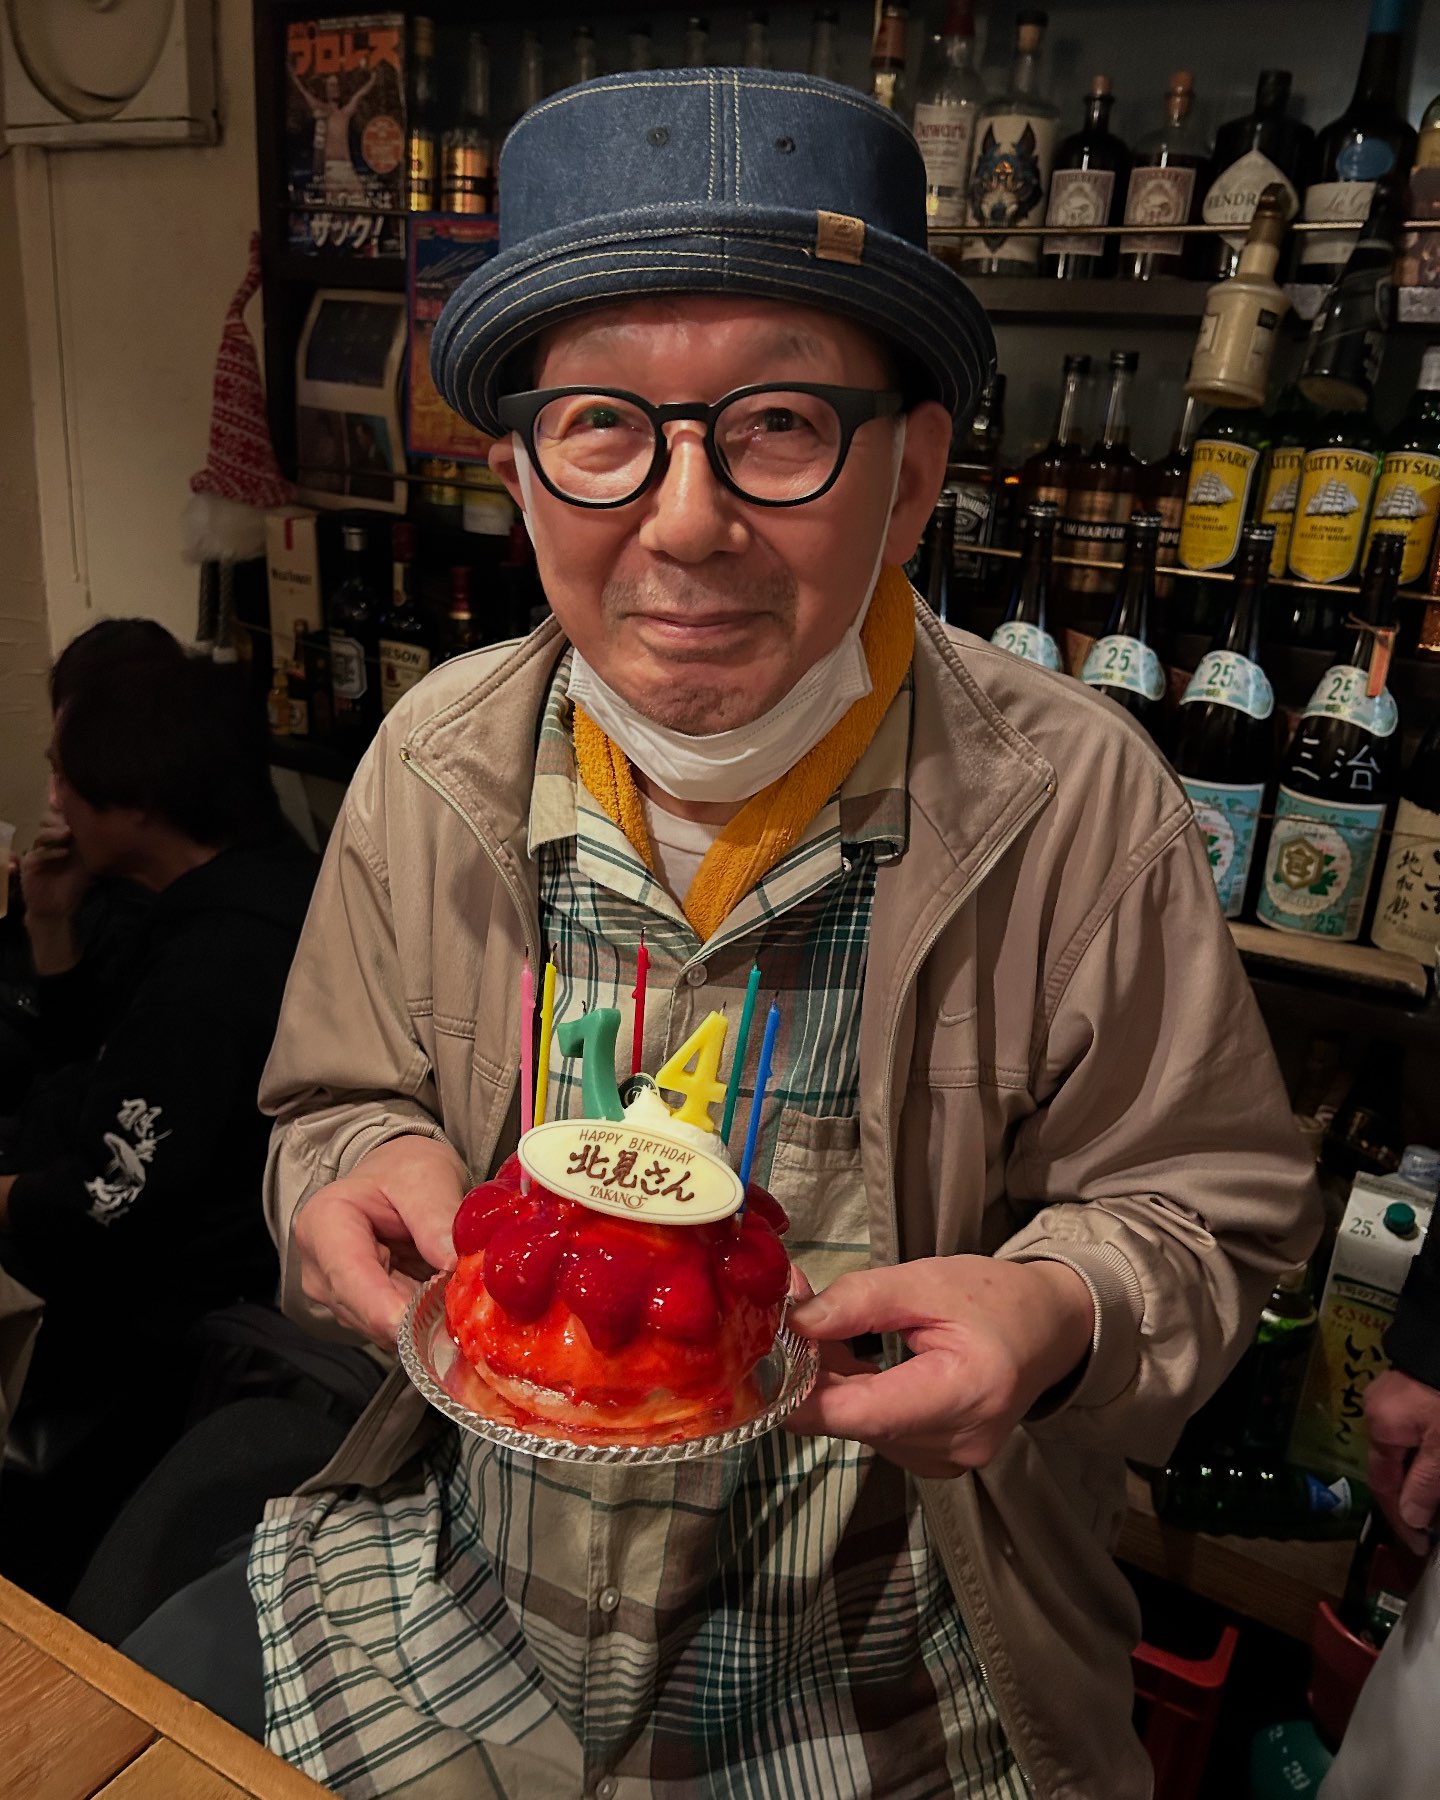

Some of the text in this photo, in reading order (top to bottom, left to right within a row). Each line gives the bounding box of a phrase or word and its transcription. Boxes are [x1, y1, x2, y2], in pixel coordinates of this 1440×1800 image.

[579, 1128, 696, 1166] HAPPY BIRTHDAY
[566, 1144, 695, 1202] 北見さん
[589, 1184, 648, 1209] TAKANO
